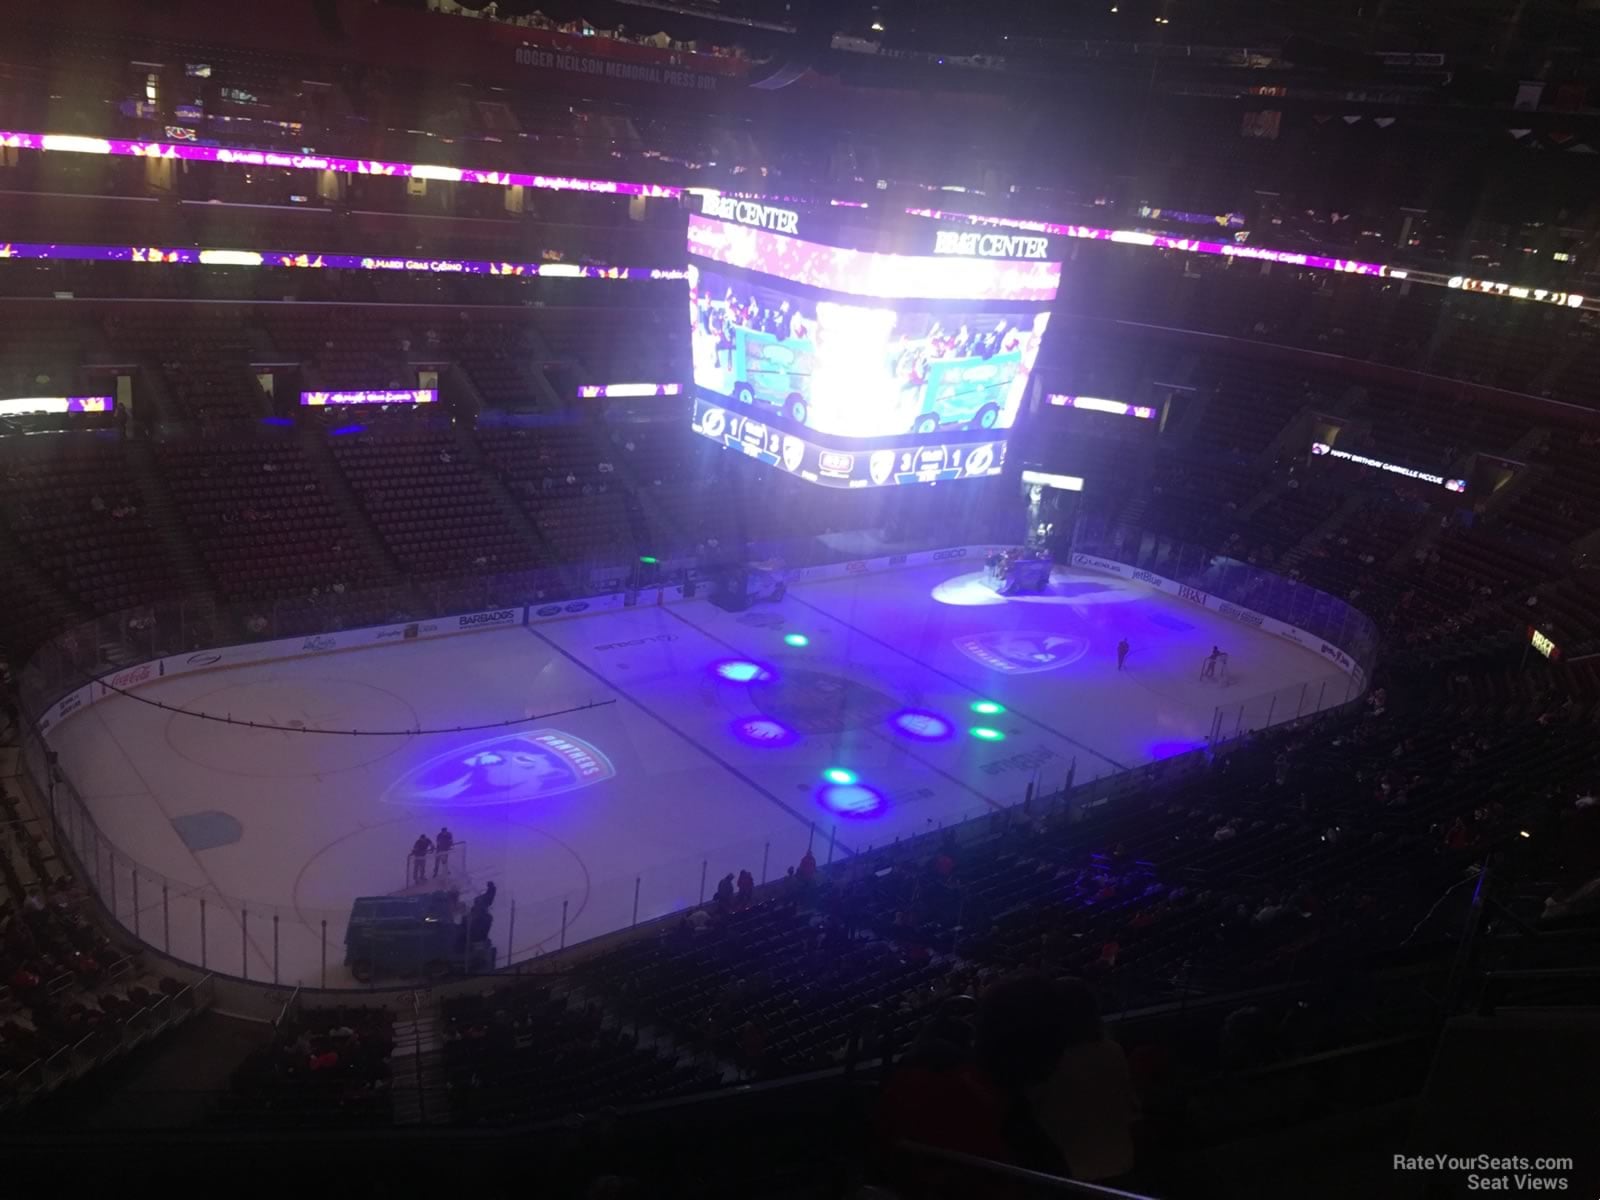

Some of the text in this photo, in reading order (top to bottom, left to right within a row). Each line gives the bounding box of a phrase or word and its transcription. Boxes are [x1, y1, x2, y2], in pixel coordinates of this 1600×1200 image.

[515, 47, 717, 90] ROGER NEILSON MEMORIAL PRESS BOX
[736, 200, 799, 235] CENTER
[979, 233, 1049, 259] CENTER
[729, 417, 739, 436] 1
[769, 434, 780, 453] 3
[900, 452, 912, 472] 3
[952, 449, 961, 467] 1
[1330, 449, 1353, 461] HAPPY
[1351, 454, 1384, 470] BIRTHDAY
[932, 548, 968, 561] GEICO
[459, 609, 514, 626] BARBADOS
[535, 735, 601, 776] PANTHERS
